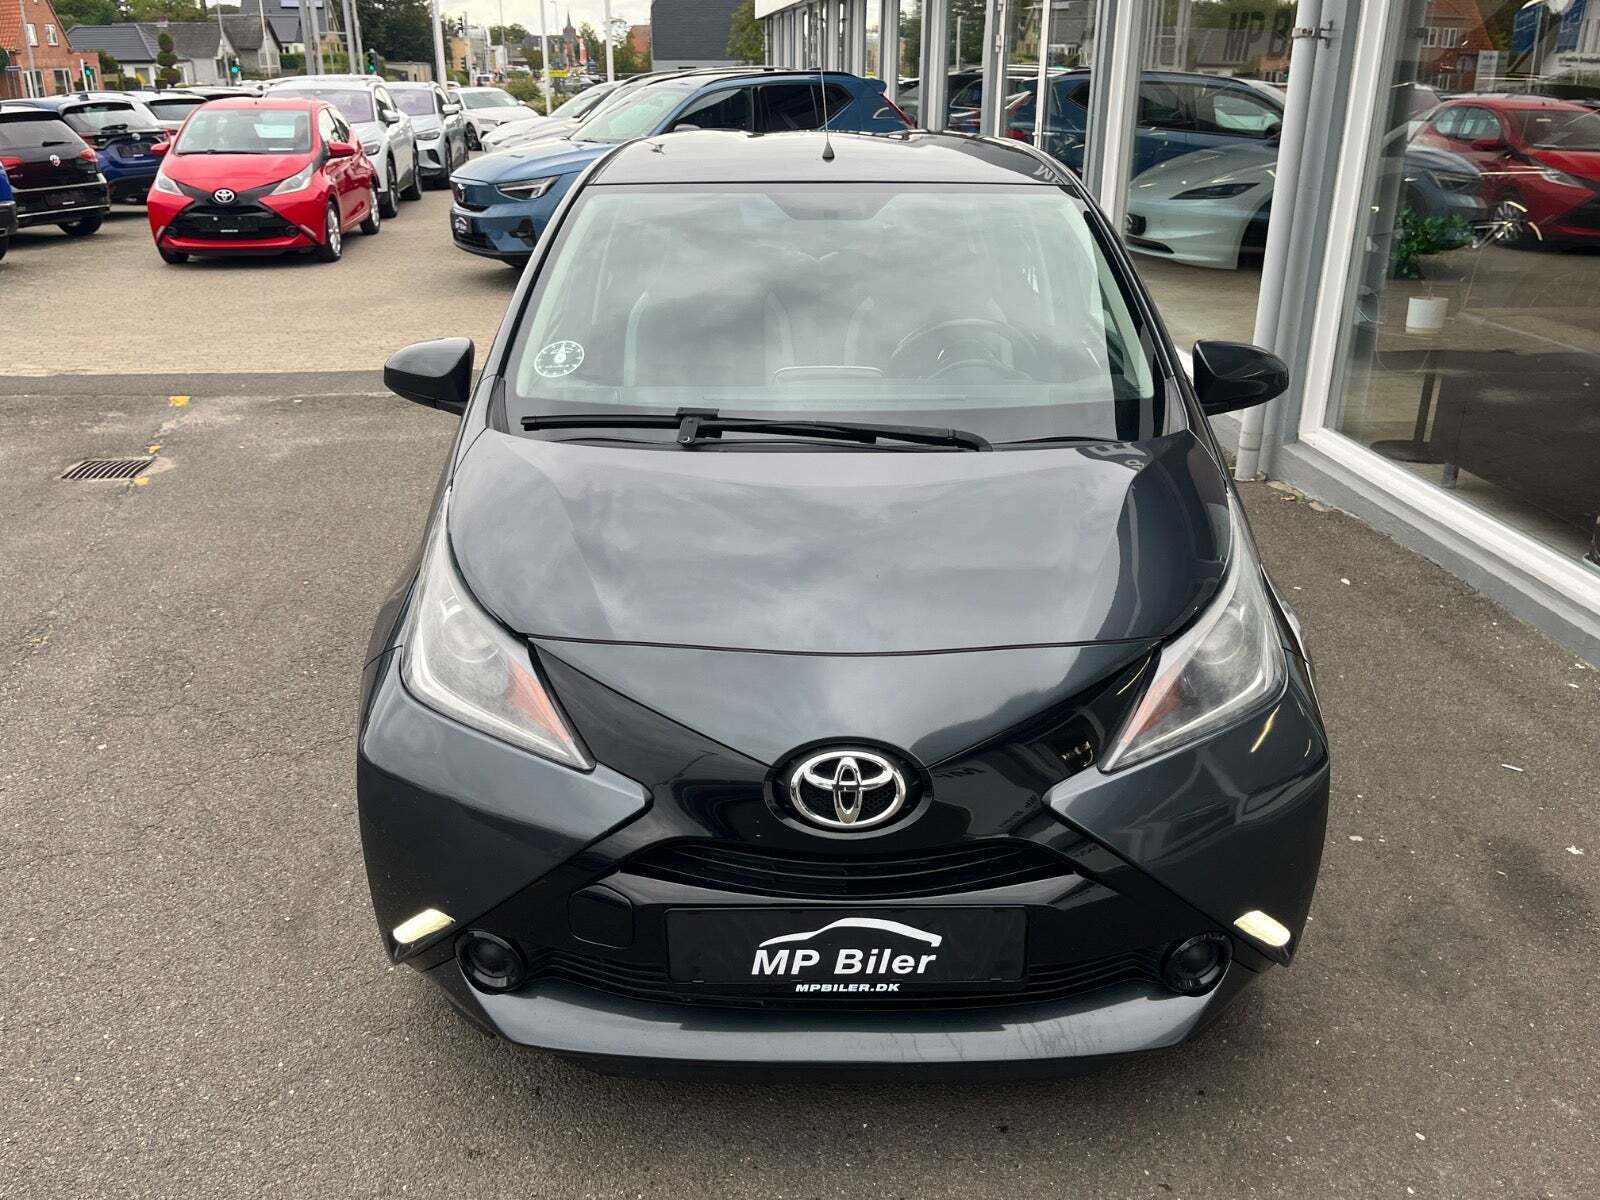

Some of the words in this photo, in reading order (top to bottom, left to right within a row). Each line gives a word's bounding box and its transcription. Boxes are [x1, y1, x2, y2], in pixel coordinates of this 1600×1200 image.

[1223, 11, 1266, 61] MP
[751, 949, 821, 976] MP
[833, 948, 937, 976] Biler
[795, 983, 901, 993] MPBILER.DK
